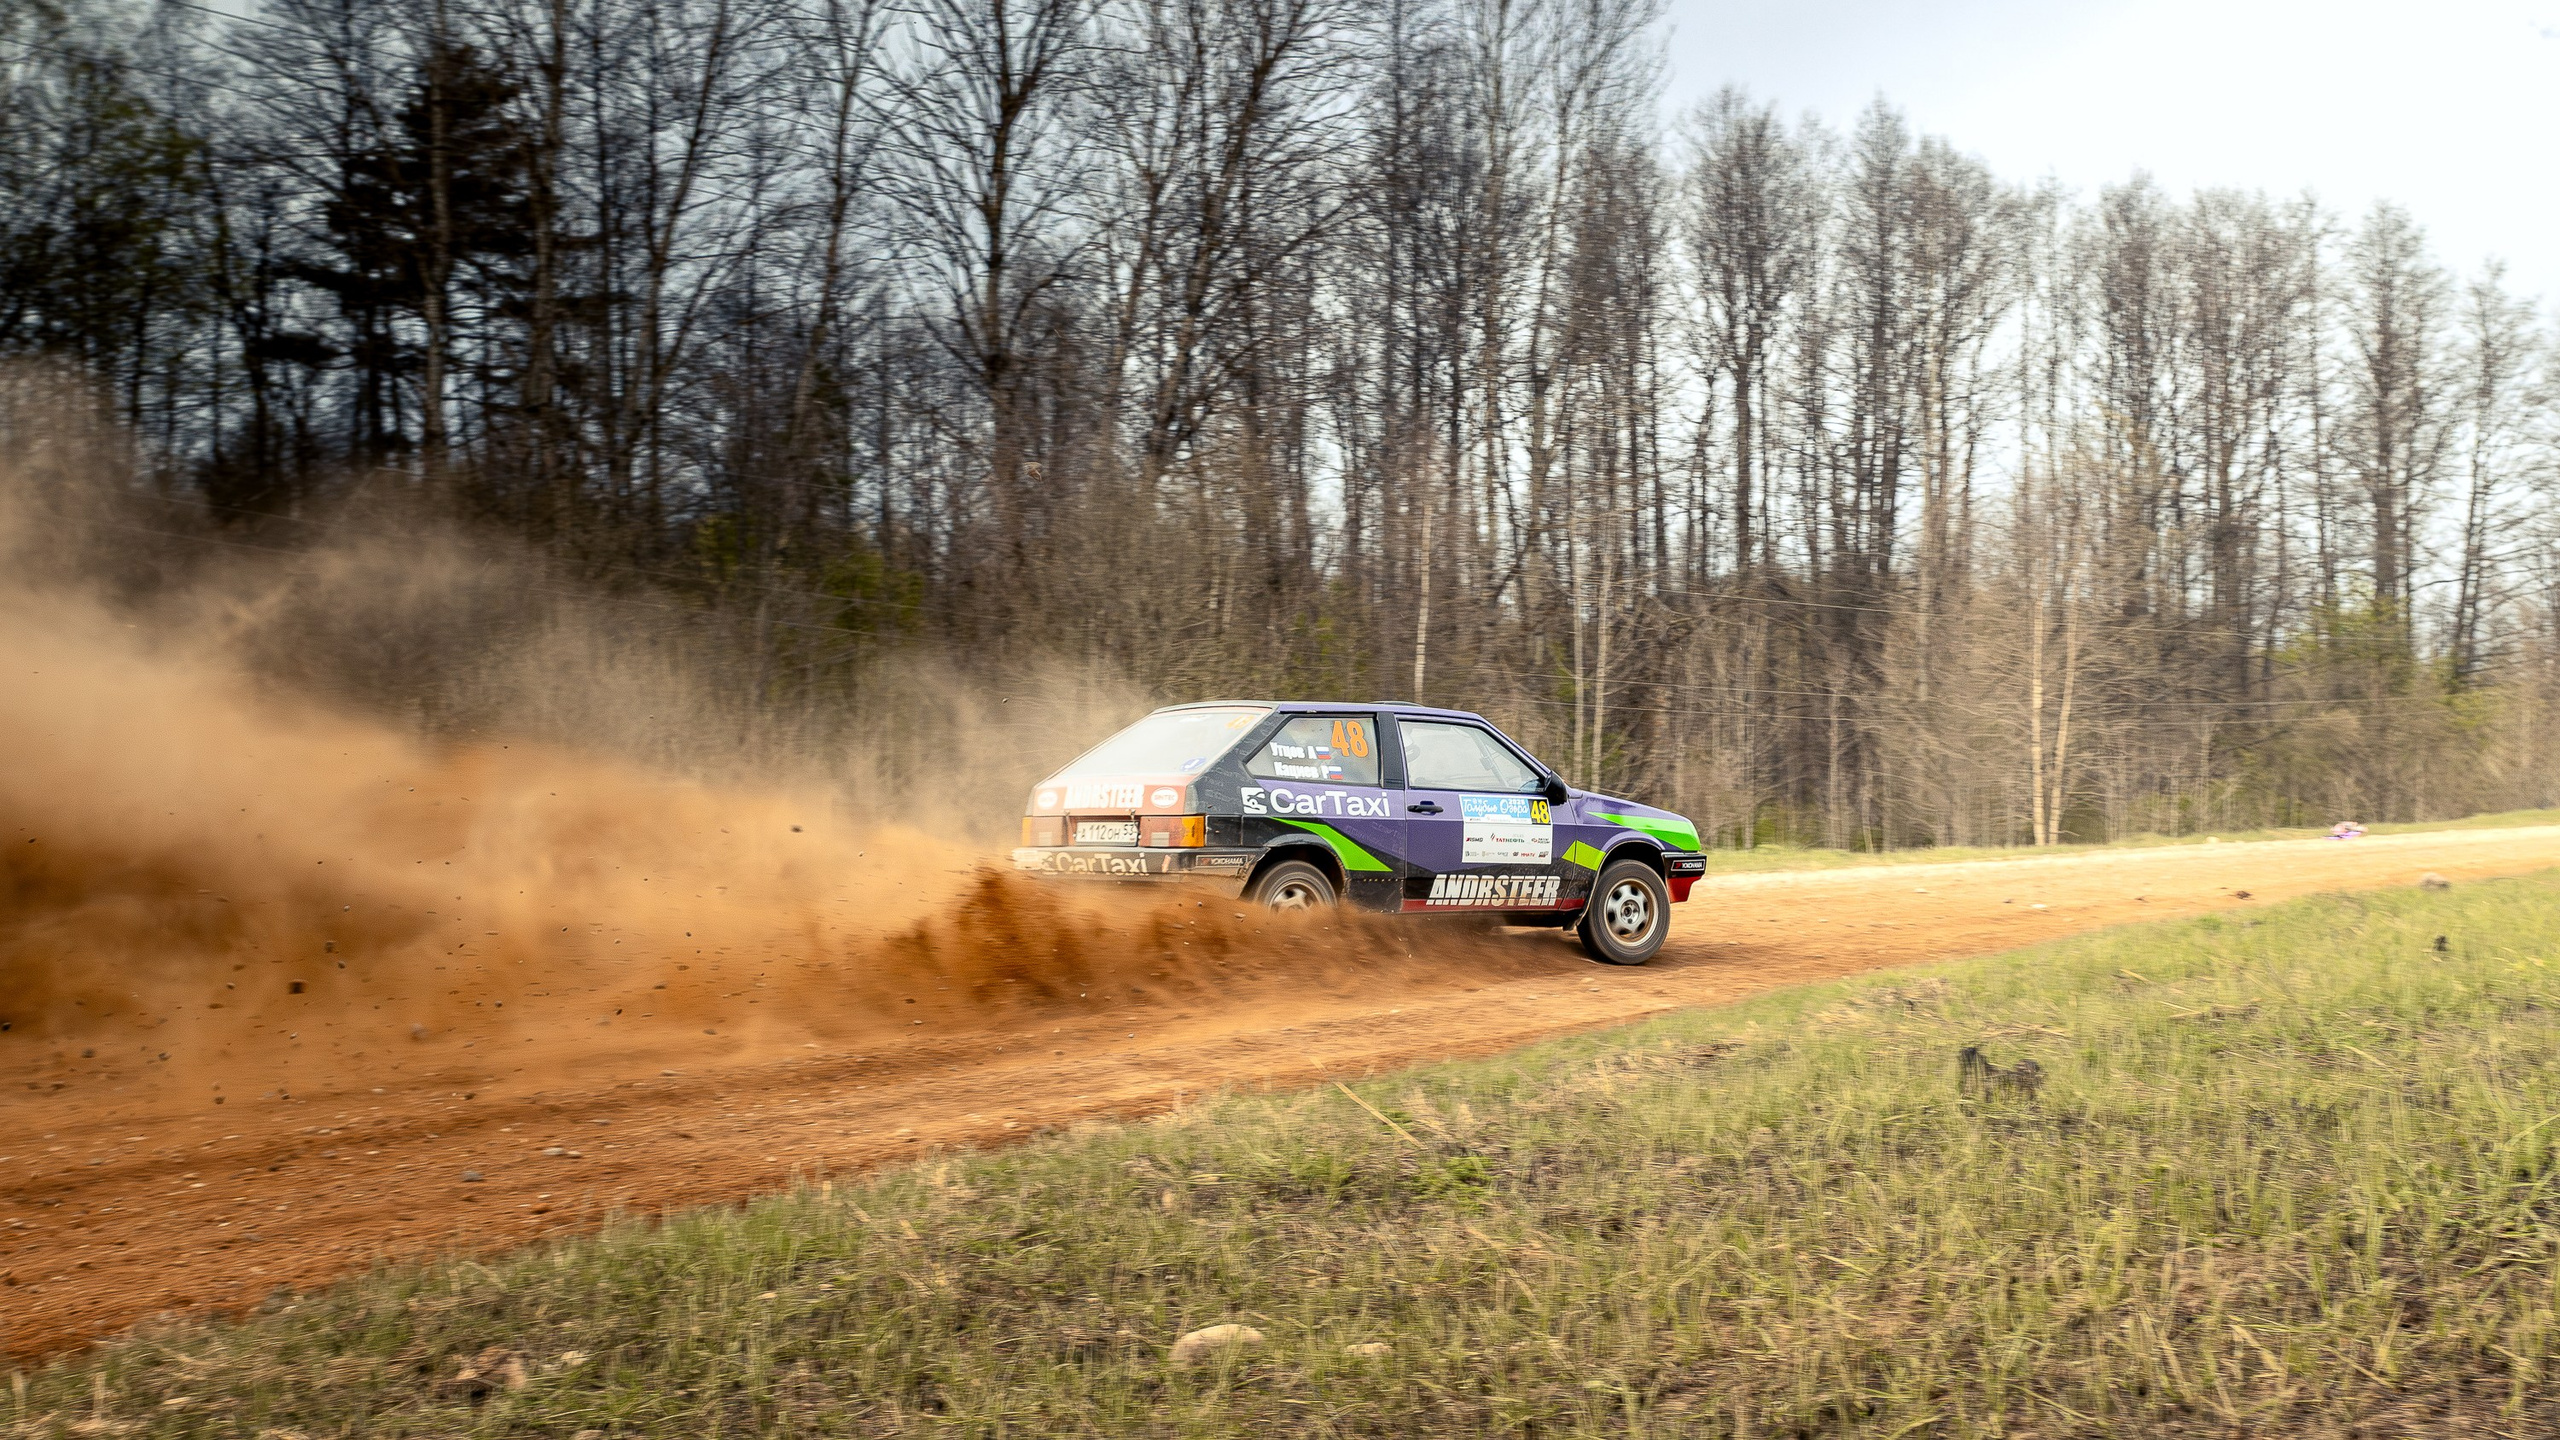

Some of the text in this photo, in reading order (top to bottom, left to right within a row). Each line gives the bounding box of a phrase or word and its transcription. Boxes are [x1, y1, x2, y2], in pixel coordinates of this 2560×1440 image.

[1331, 720, 1369, 757] 48
[1270, 788, 1390, 817] CarTaxi
[1531, 800, 1550, 824] 48
[1055, 852, 1149, 876] CarTaxi
[1426, 874, 1561, 907] ANDRSTEER
